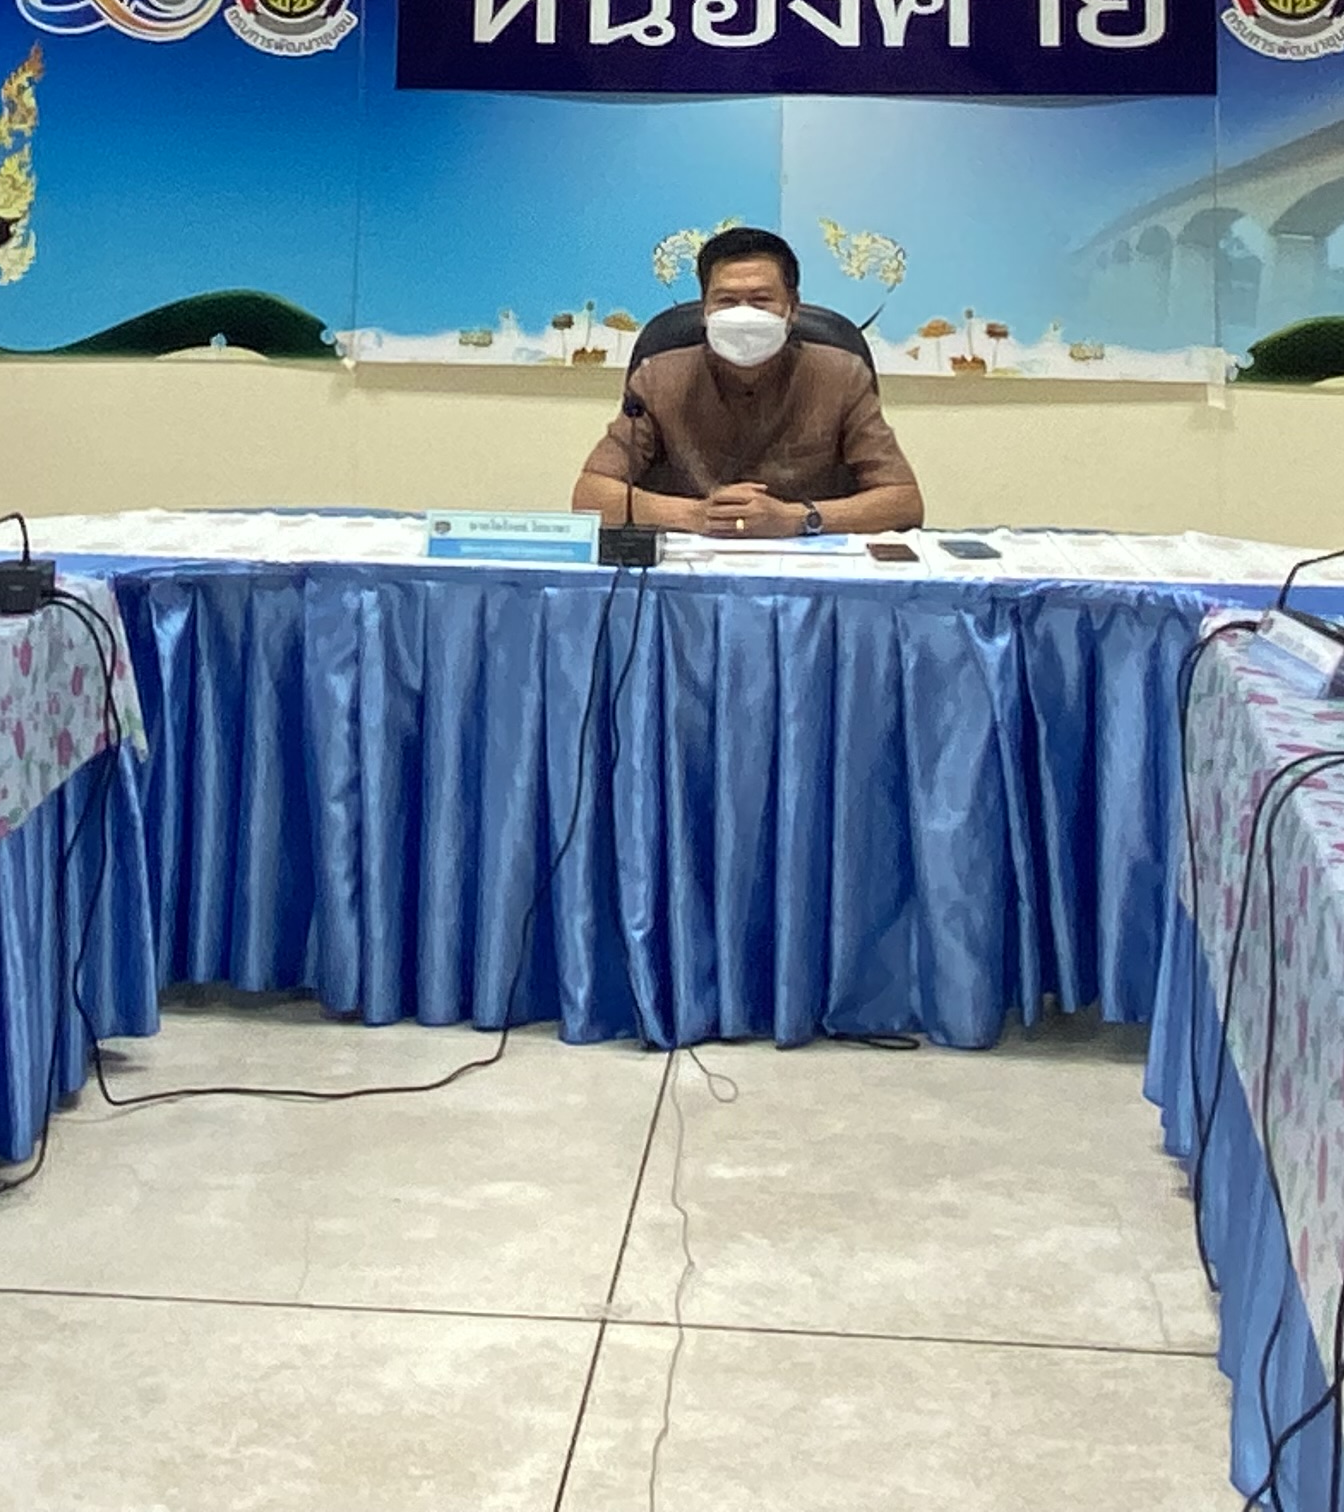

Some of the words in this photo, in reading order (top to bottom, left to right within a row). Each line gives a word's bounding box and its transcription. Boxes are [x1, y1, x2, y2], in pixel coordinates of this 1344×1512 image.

[228, 9, 355, 53] กรมการพัฒนาชุมชน
